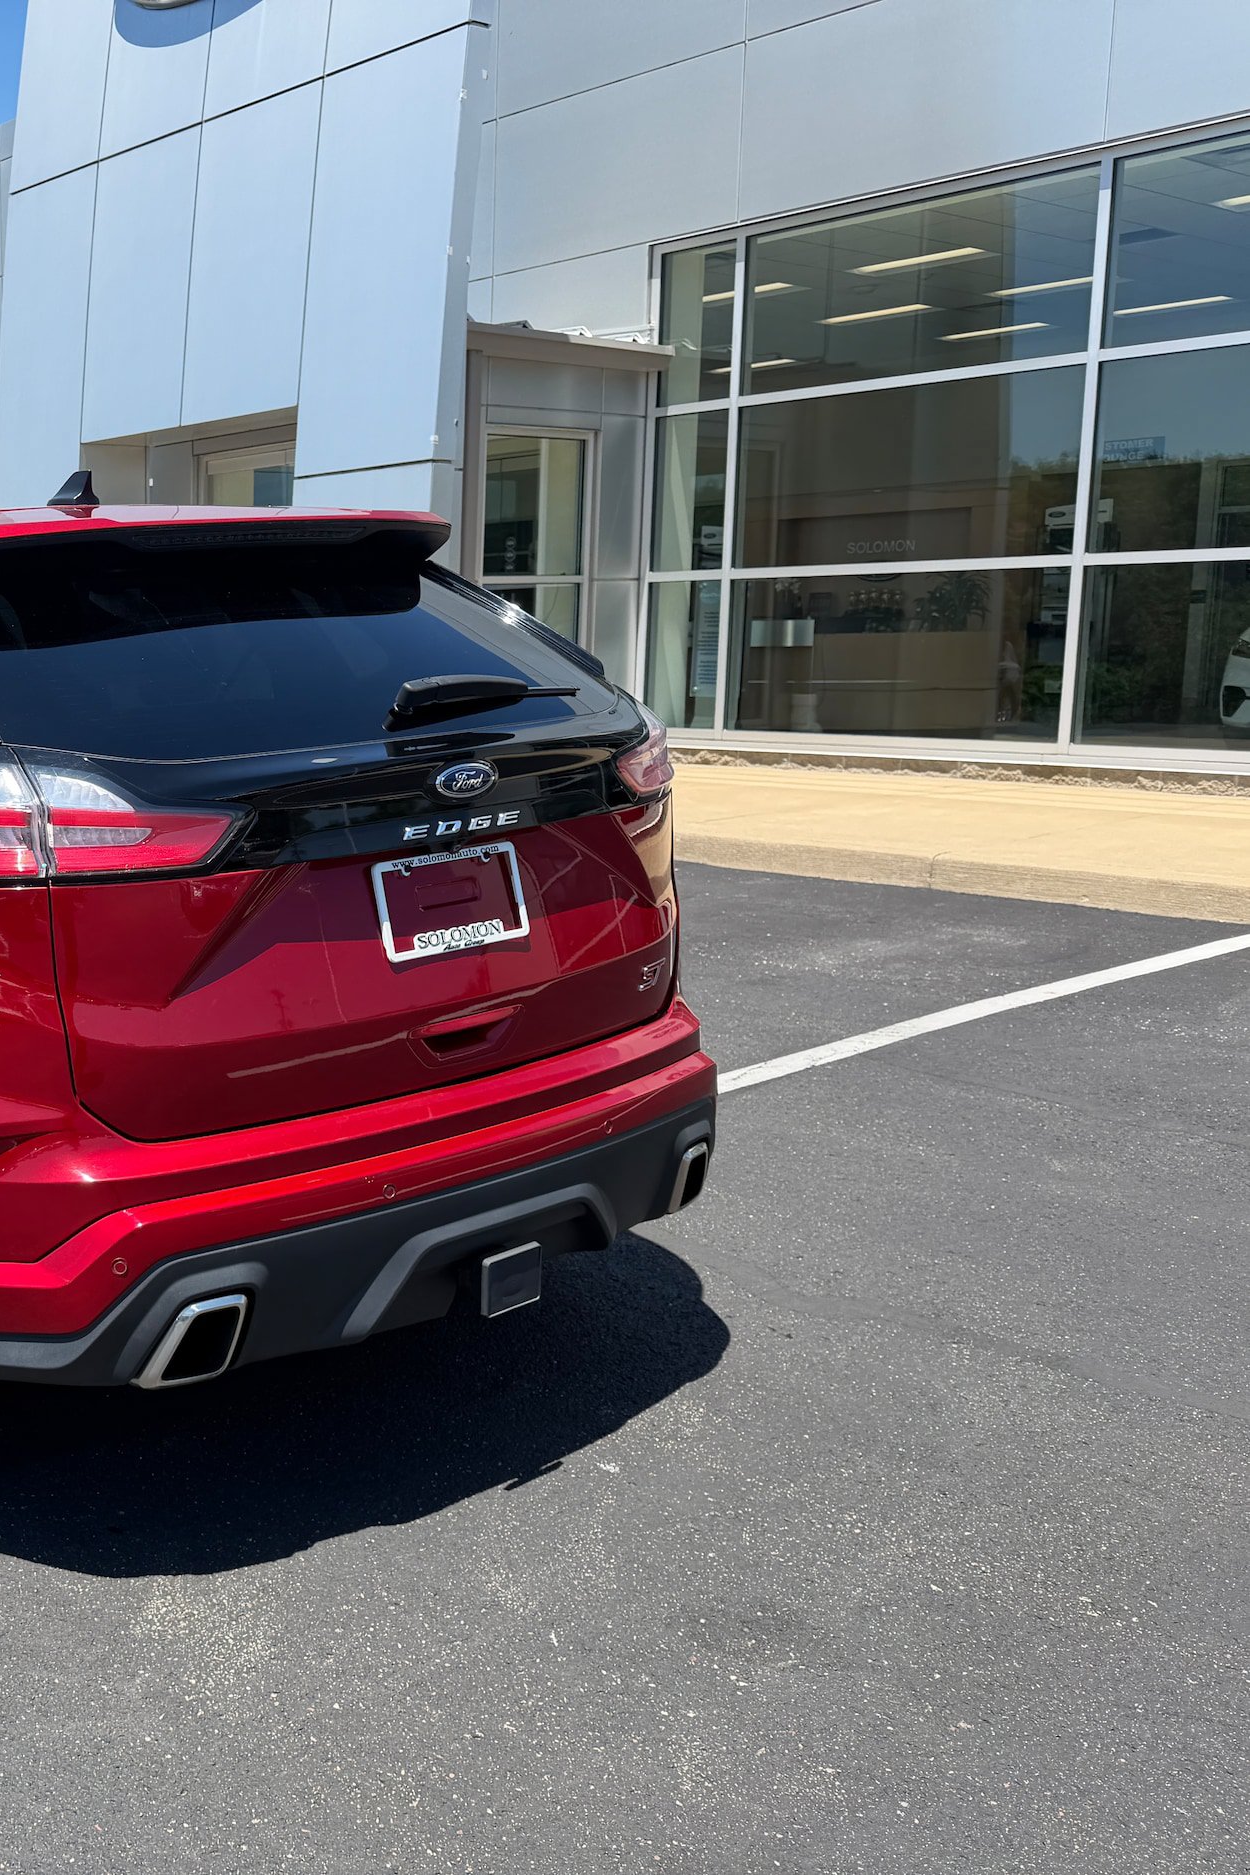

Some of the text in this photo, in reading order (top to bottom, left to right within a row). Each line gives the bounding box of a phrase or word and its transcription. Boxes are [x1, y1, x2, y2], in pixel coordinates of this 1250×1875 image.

[1104, 438, 1154, 451] STOMER
[1102, 450, 1145, 463] OUNGE
[846, 539, 916, 554] SOLOMON
[452, 770, 484, 791] Ford
[402, 810, 521, 841] EDGE
[391, 845, 500, 870] www.solomonauto.com
[416, 920, 502, 950] SOLOMON
[637, 957, 667, 992] ST
